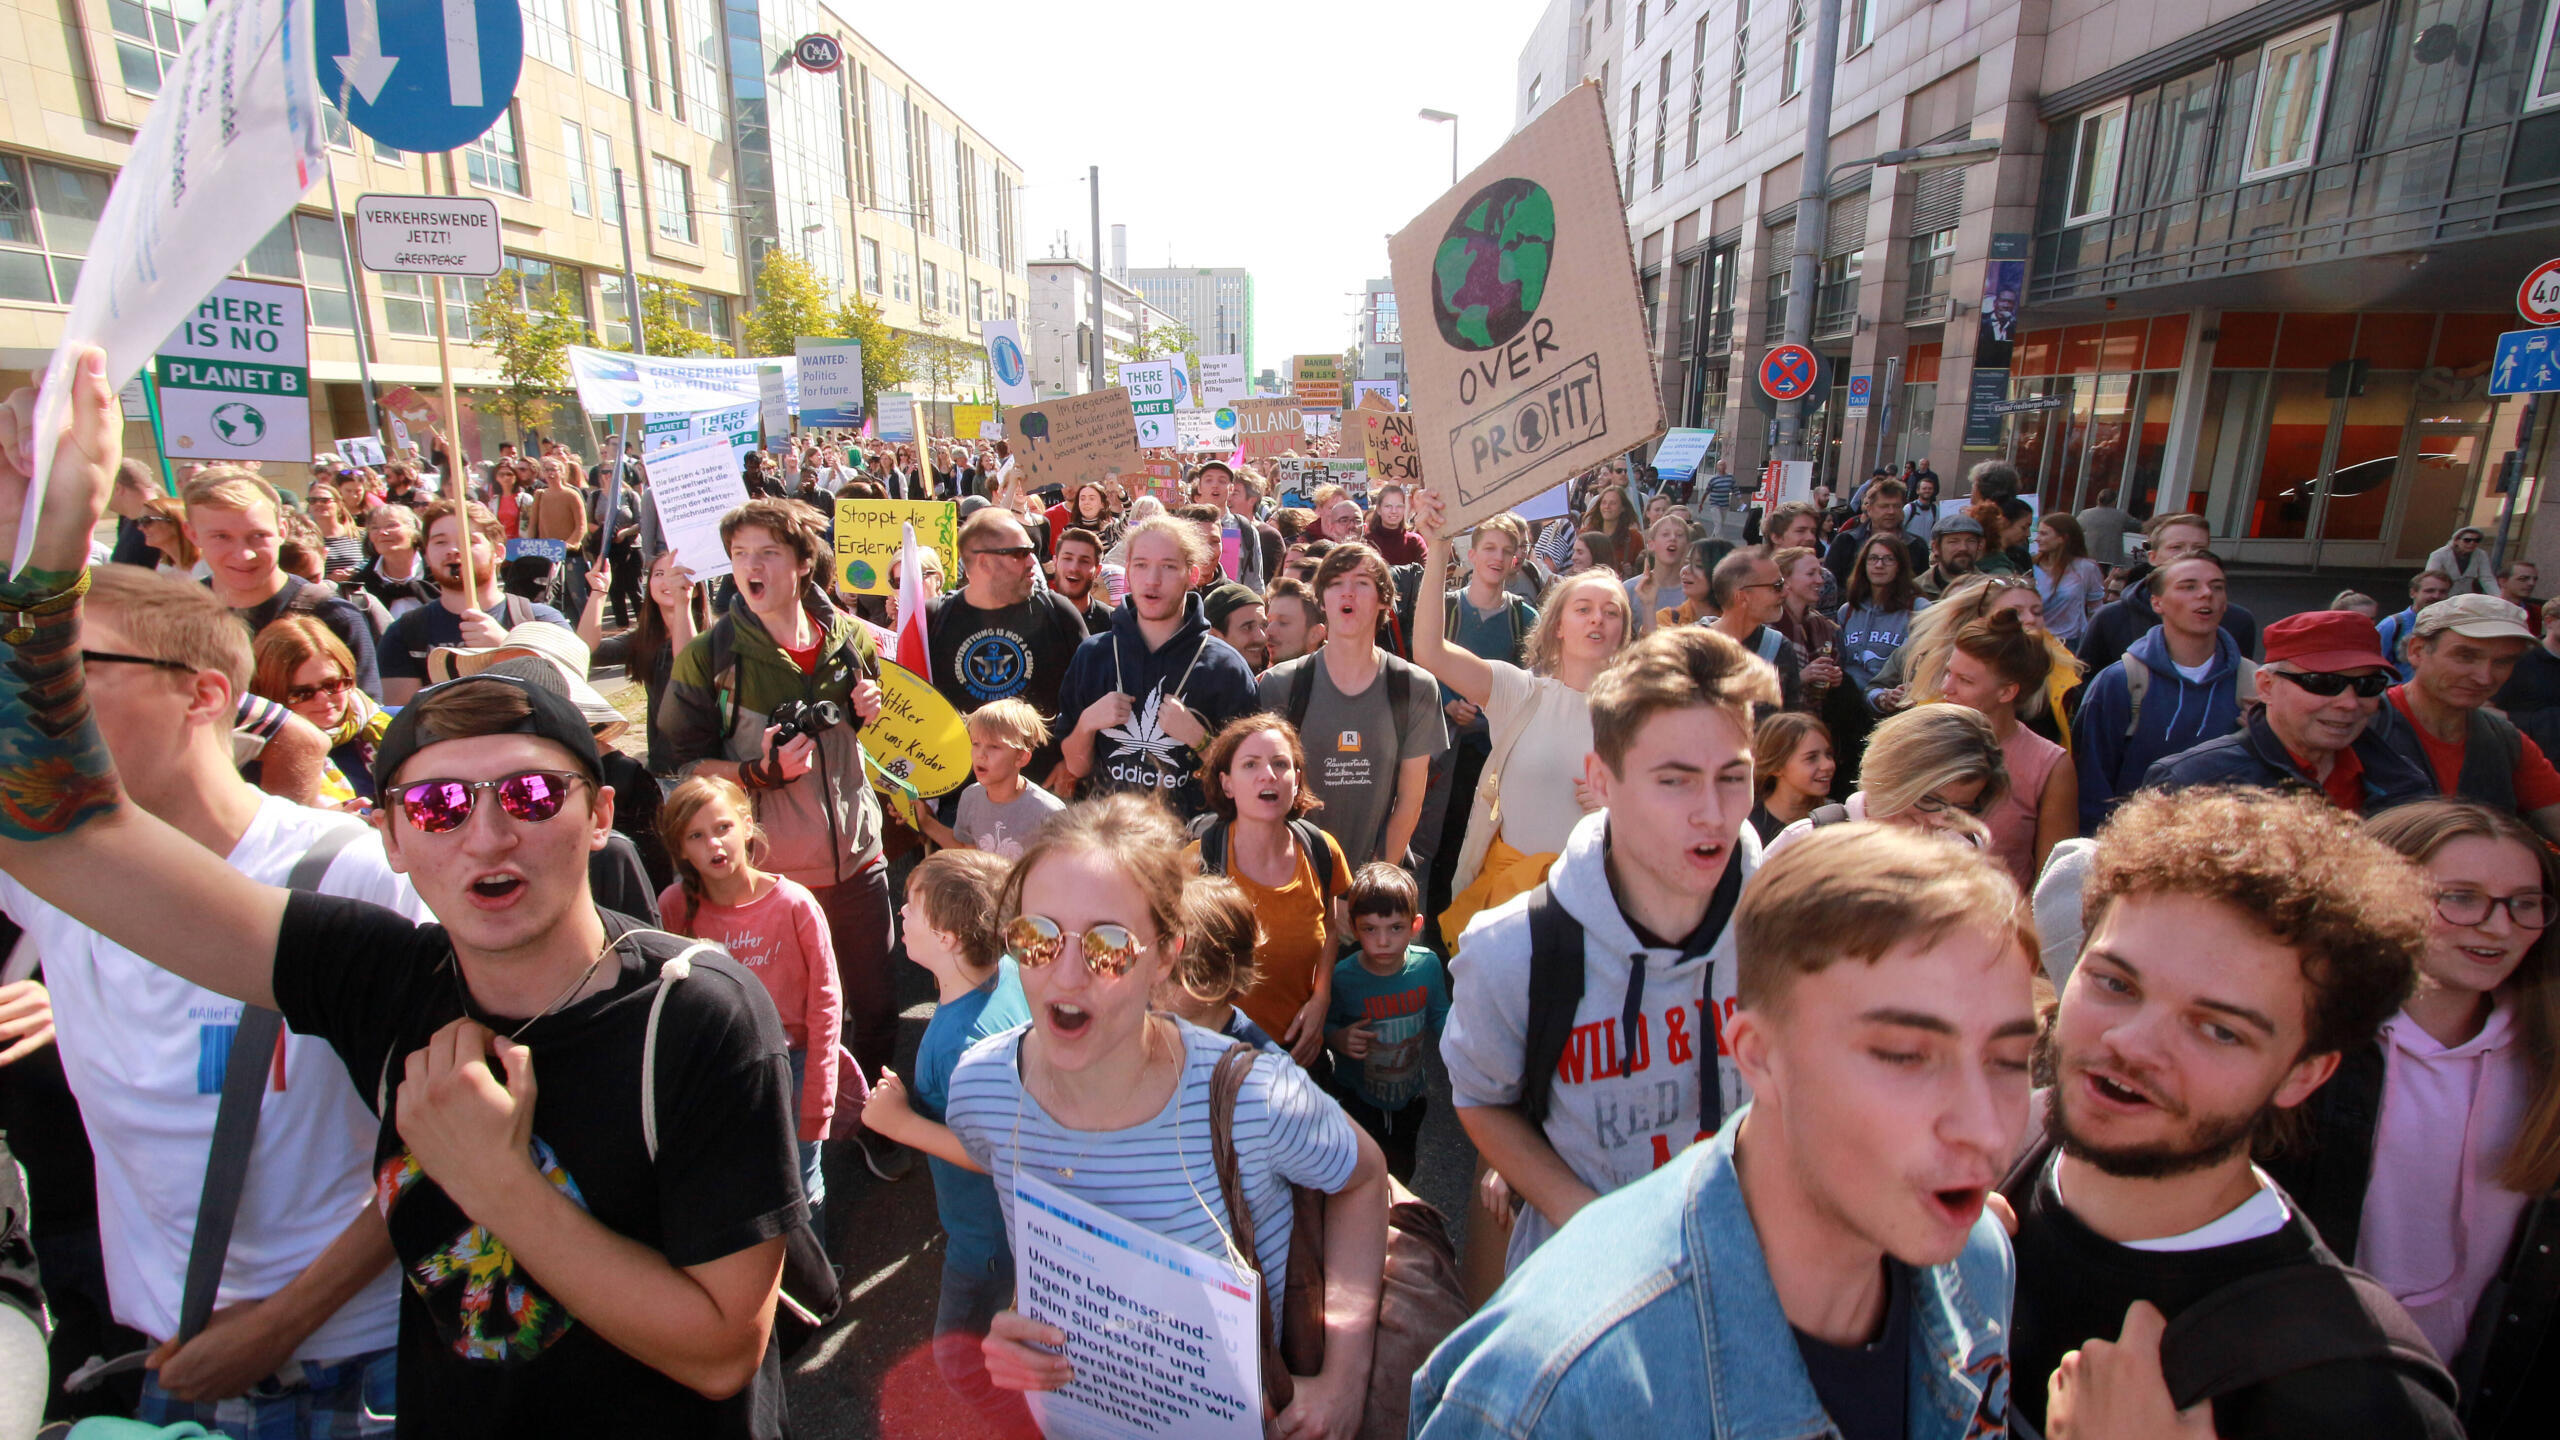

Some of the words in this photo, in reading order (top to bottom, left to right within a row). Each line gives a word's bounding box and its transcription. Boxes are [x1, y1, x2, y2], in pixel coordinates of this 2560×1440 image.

[803, 43, 833, 60] C&A
[366, 210, 488, 227] VERKEHRSWENDE
[407, 230, 452, 244] JETZT!
[394, 252, 467, 266] GREENPEACE
[199, 296, 284, 327] HERE
[185, 321, 219, 347] IS
[231, 326, 279, 353] NO
[649, 361, 768, 378] ENTREPRENEUR
[802, 354, 848, 366] WANTED:
[1222, 361, 1228, 369] in
[1304, 358, 1332, 367] BANKER
[1460, 318, 1559, 405] OVER
[169, 363, 274, 391] PLANET
[281, 372, 298, 391] B
[803, 370, 837, 381] Politics
[1126, 370, 1163, 383] THERE
[1301, 370, 1314, 379] FOR
[654, 379, 682, 390] FOR
[685, 379, 740, 392] FUTURE
[804, 386, 817, 396] for
[819, 385, 852, 395] future.
[1130, 384, 1142, 396] IS
[1145, 382, 1162, 395] NO
[1204, 385, 1224, 393] Alltag.
[1360, 387, 1392, 397] TERE
[1056, 403, 1070, 416] Im
[1072, 393, 1123, 413] Gegensatz
[1133, 402, 1161, 414] LANET
[1163, 402, 1170, 412] B
[1851, 397, 1868, 405] TAXI
[648, 422, 680, 432] PLANET
[681, 420, 689, 428] B
[701, 409, 749, 426] THERE
[1238, 408, 1302, 434] OLLAND
[1471, 374, 1592, 475] PROFIT
[702, 425, 718, 436] IS
[723, 420, 745, 432] NO
[1087, 425, 1103, 437] Welt
[1105, 420, 1126, 430] nicht
[1262, 434, 1299, 454] NOT
[1369, 432, 1389, 451] bist
[1400, 436, 1416, 453] du
[656, 478, 667, 487] Die
[668, 472, 694, 485] letzten
[701, 464, 723, 475] Jahre
[1280, 461, 1299, 471] WE
[1304, 461, 1324, 470] ARE
[658, 485, 680, 496] waren
[680, 475, 714, 489] weltweit
[715, 472, 728, 481] die
[1281, 472, 1300, 481] OUT
[1341, 472, 1355, 480] OF
[1340, 481, 1366, 491] TIME
[661, 491, 696, 505] wärmsten
[697, 486, 712, 496] seit
[663, 502, 687, 515] Beginn
[688, 497, 700, 507] der
[702, 492, 734, 504] Wetter-
[841, 504, 898, 529] Stoppt
[905, 508, 925, 529] die
[520, 540, 549, 548] MAMA
[996, 628, 1004, 636] IS
[1005, 630, 1023, 644] NOT
[1020, 643, 1027, 651] A
[1024, 650, 1034, 679] CRIME
[1346, 733, 1354, 742] R
[884, 731, 902, 749] uns
[905, 738, 946, 772] Kinder
[1108, 762, 1190, 788] ddicted
[1325, 767, 1354, 777] drücken
[1355, 767, 1370, 776] und
[725, 930, 763, 949] better
[1361, 985, 1428, 1020] JUNIOR
[1557, 1012, 1650, 1084] WILD
[1665, 1005, 1692, 1066] &
[1594, 1080, 1680, 1149] RED
[1027, 1221, 1049, 1242] Fakt
[1051, 1233, 1063, 1247] 13
[1029, 1245, 1082, 1285] Unsere
[1087, 1276, 1213, 1341] Lebensgrund-
[1029, 1266, 1070, 1301] lagen
[1075, 1291, 1109, 1320] sind
[1115, 1312, 1211, 1362] gefährdet.
[1029, 1286, 1067, 1318] Beim
[1072, 1311, 1164, 1358] Stickstoff-
[1170, 1354, 1205, 1379] und
[1029, 1306, 1184, 1386] Phphorkreislauf
[1190, 1380, 1247, 1411] sowie
[1040, 1338, 1136, 1381] iodiversität
[1142, 1375, 1200, 1409] haben
[1205, 1402, 1236, 1422] wir
[1092, 1372, 1190, 1419] planetaren
[1048, 1385, 1160, 1434] erschritten.
[1108, 1391, 1171, 1425] bereits
